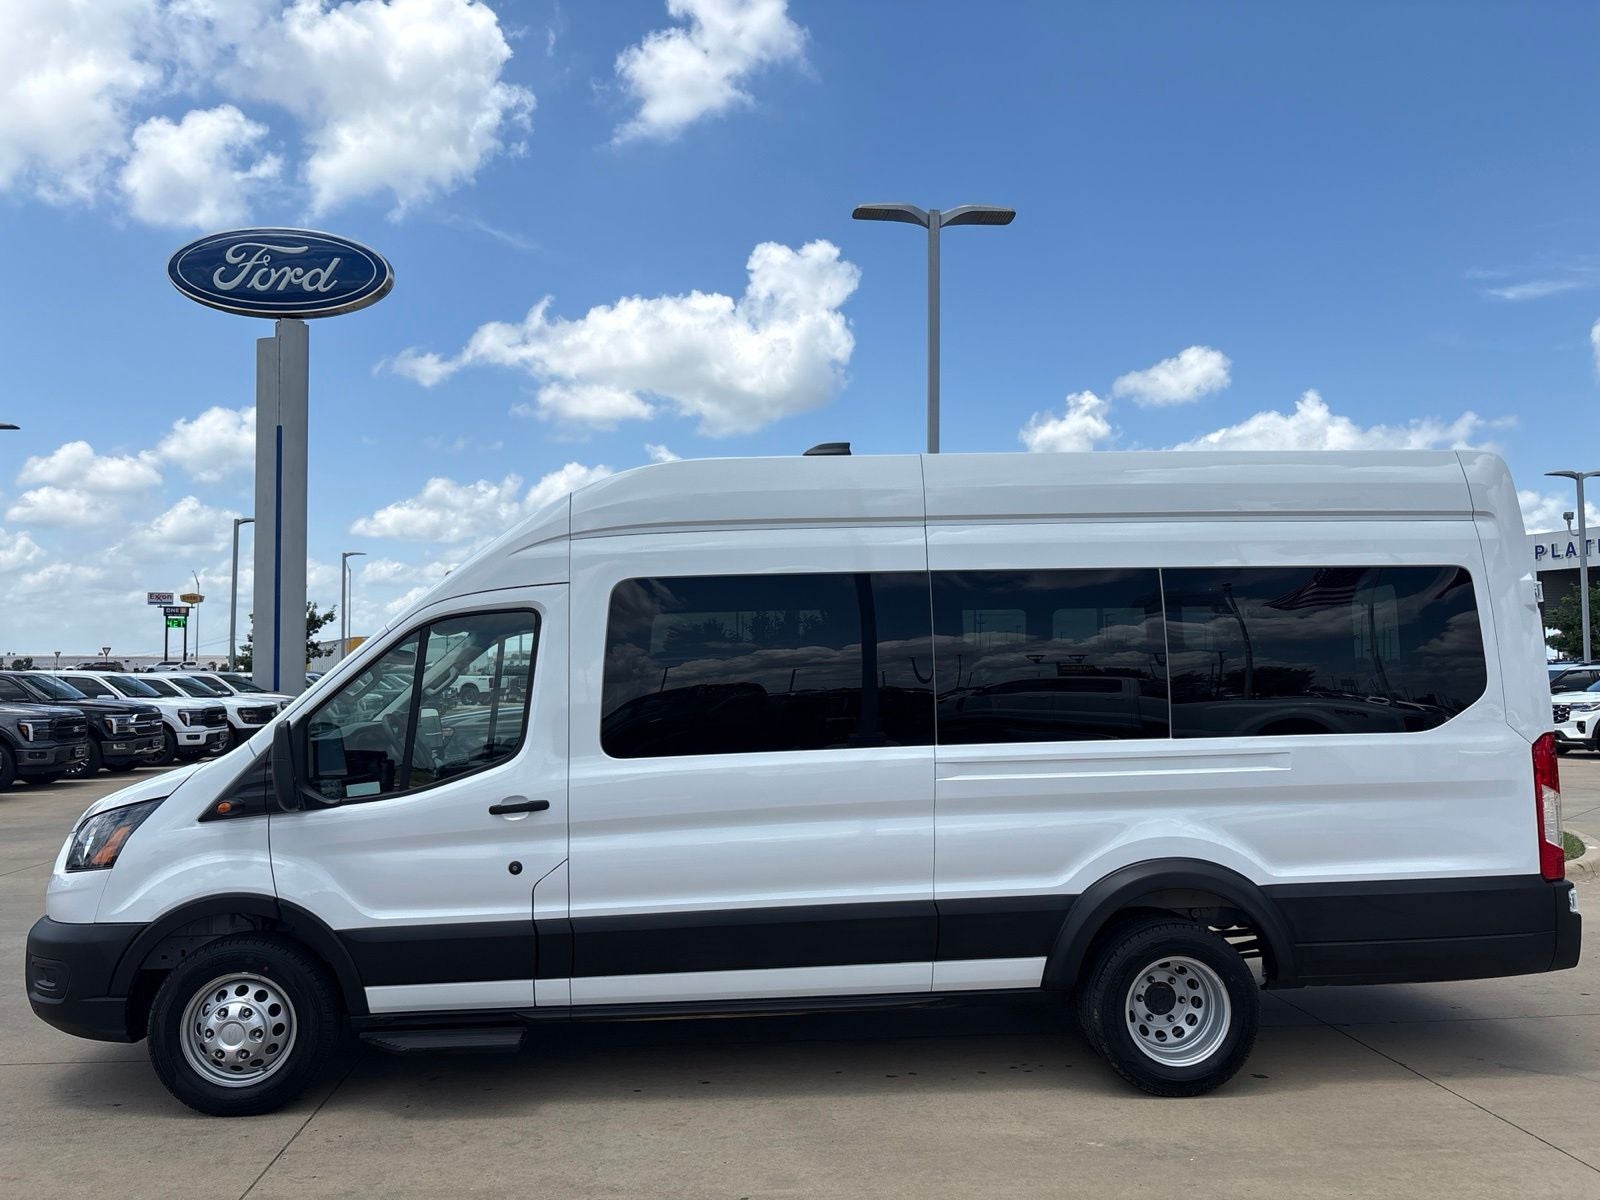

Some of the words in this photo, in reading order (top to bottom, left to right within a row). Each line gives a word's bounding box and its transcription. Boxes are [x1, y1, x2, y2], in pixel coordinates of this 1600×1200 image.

[213, 242, 340, 293] Ford
[1534, 538, 1600, 560] PLAT
[150, 593, 172, 601] Exxon
